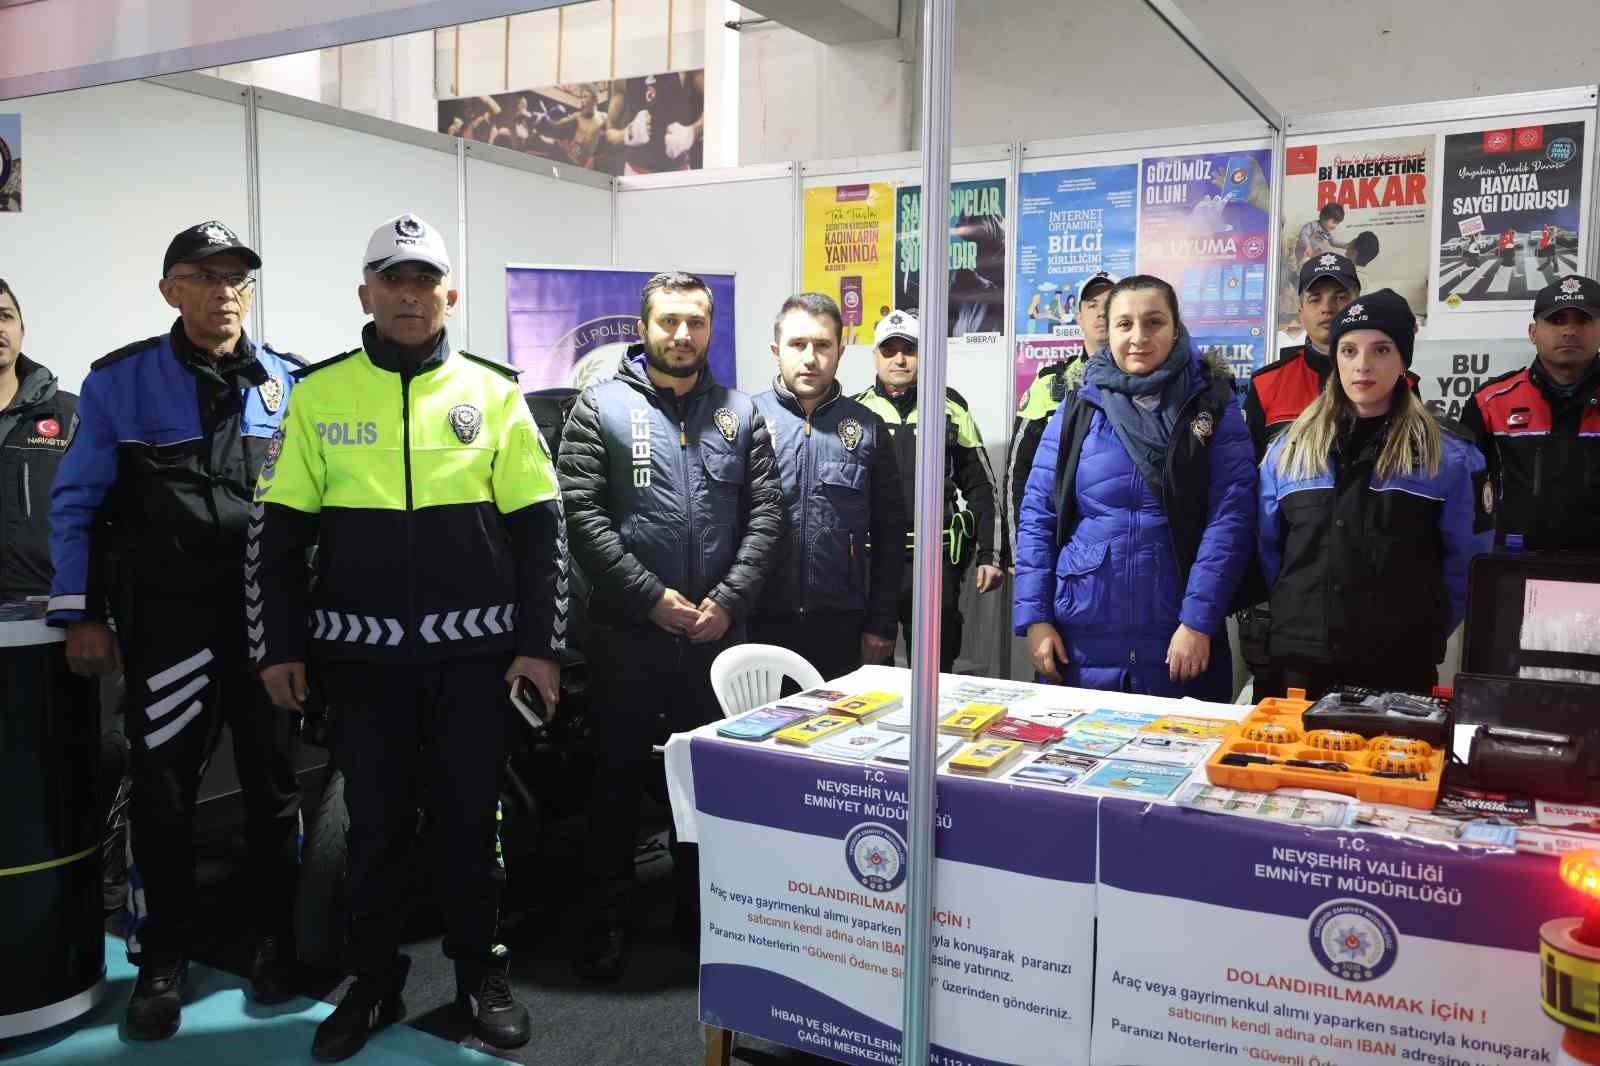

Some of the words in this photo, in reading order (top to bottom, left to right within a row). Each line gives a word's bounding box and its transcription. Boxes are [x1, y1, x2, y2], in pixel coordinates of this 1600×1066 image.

[1147, 160, 1212, 184] GÖZÜMÜZ
[1146, 183, 1187, 205] OLUN!
[1318, 174, 1426, 211] BAKAR
[1481, 173, 1538, 196] HAYATA
[1452, 194, 1498, 215] SAYGI
[1502, 189, 1569, 212] DURUŞU
[825, 230, 879, 246] KADINLARIN
[1048, 231, 1103, 253] BİLGİ
[825, 244, 880, 264] YANINDA
[1453, 354, 1489, 374] BU
[864, 770, 887, 784] T.C.
[817, 779, 881, 800] NEVŞEHİR
[804, 793, 861, 814] EMNİYET
[1336, 837, 1370, 853] T.C.
[1272, 846, 1361, 873] NEVŞEHİR
[1366, 859, 1444, 883] VALİLİĞİ
[1254, 864, 1331, 889] EMNİYET
[1337, 875, 1463, 907] MÜDÜRLÜĞÜ
[710, 883, 728, 902] Araç
[729, 891, 753, 906] veya
[755, 894, 820, 920] gayrimenkul
[823, 907, 850, 924] alımı
[851, 914, 902, 937] yaparken
[953, 937, 1014, 963] konuşarak
[1022, 955, 1072, 974] paranızı
[932, 907, 962, 928] İÇİN
[747, 911, 790, 932] satıcının
[793, 919, 822, 938] kendi
[825, 927, 855, 944] adına
[857, 933, 880, 948] olan
[963, 960, 1013, 983] yatırınız.
[710, 922, 745, 943] Paranızı
[748, 932, 800, 954] Noterlerin
[849, 954, 889, 976] Ödeme
[942, 979, 999, 1004] üzerinden
[1003, 994, 1072, 1020] gönderiniz.
[1227, 967, 1424, 1015] DOLANDIRILMAMAK
[1430, 1001, 1474, 1024] İÇİN
[1112, 969, 1142, 993] Araç
[1145, 982, 1178, 1000] veya
[1181, 986, 1270, 1017] gayrimenkul
[1273, 1003, 1310, 1022] alımı
[1313, 1012, 1385, 1037] yaparken
[1390, 1022, 1457, 1048] satıcıyla
[1461, 1033, 1551, 1063] konuşarak
[771, 1005, 804, 1026] İHBAR
[806, 1017, 821, 1032] VE
[822, 1021, 902, 1054] ŞİKAYETLERİN
[798, 1029, 830, 1050] ÇAĞRI
[1112, 1018, 1165, 1043] Paranızı
[1168, 1029, 1239, 1057] Noterlerin
[1168, 1004, 1228, 1030] satıcının
[1231, 1014, 1272, 1039] kendi
[1275, 1023, 1317, 1045] adına
[1319, 1032, 1353, 1051] olan
[1357, 1038, 1397, 1057] IBAN
